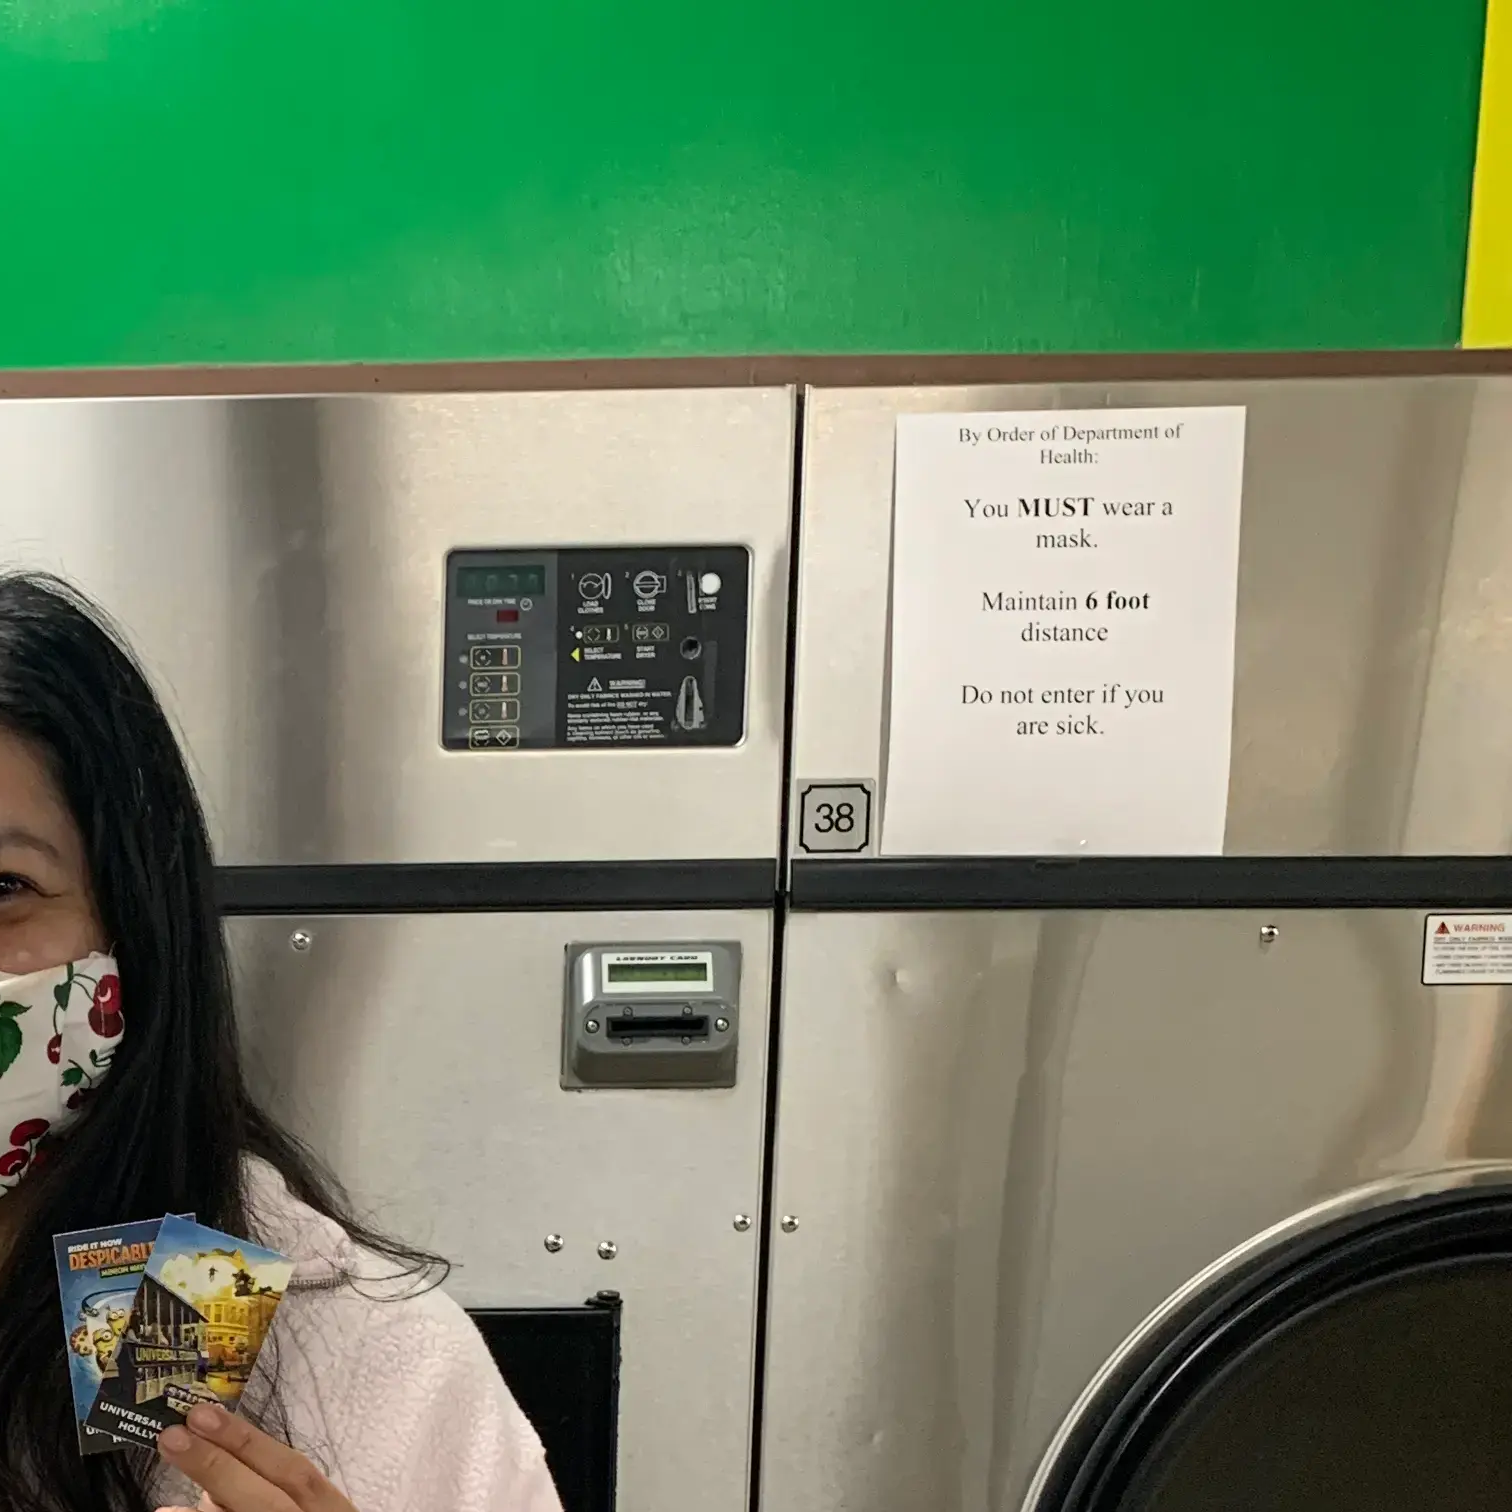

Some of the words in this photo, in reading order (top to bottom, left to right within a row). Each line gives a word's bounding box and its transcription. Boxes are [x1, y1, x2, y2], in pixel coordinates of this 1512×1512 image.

[959, 427, 982, 446] By
[987, 426, 1035, 442] Order
[1040, 425, 1060, 441] of
[1063, 425, 1159, 444] Department
[1164, 423, 1184, 439] of
[1040, 448, 1099, 464] Health:
[964, 498, 1009, 518] You
[1018, 497, 1095, 518] MUST
[1103, 501, 1155, 517] wear
[1161, 501, 1173, 516] a
[1036, 528, 1098, 548] mask.
[982, 591, 1077, 611] Maintain
[1085, 591, 1099, 610] 6
[1106, 590, 1151, 610] foot
[1021, 622, 1109, 642] distance
[961, 684, 993, 704] Do
[1000, 688, 1034, 703] not
[1041, 688, 1095, 703] enter
[1101, 683, 1121, 703] if
[1124, 688, 1164, 709] you
[1016, 720, 1049, 735] are
[1056, 714, 1105, 735] sick.
[814, 802, 854, 833] 38
[1453, 923, 1505, 932] WARNING
[100, 1401, 163, 1430] UNIVERSAL
[118, 1420, 160, 1440] HOLLY
